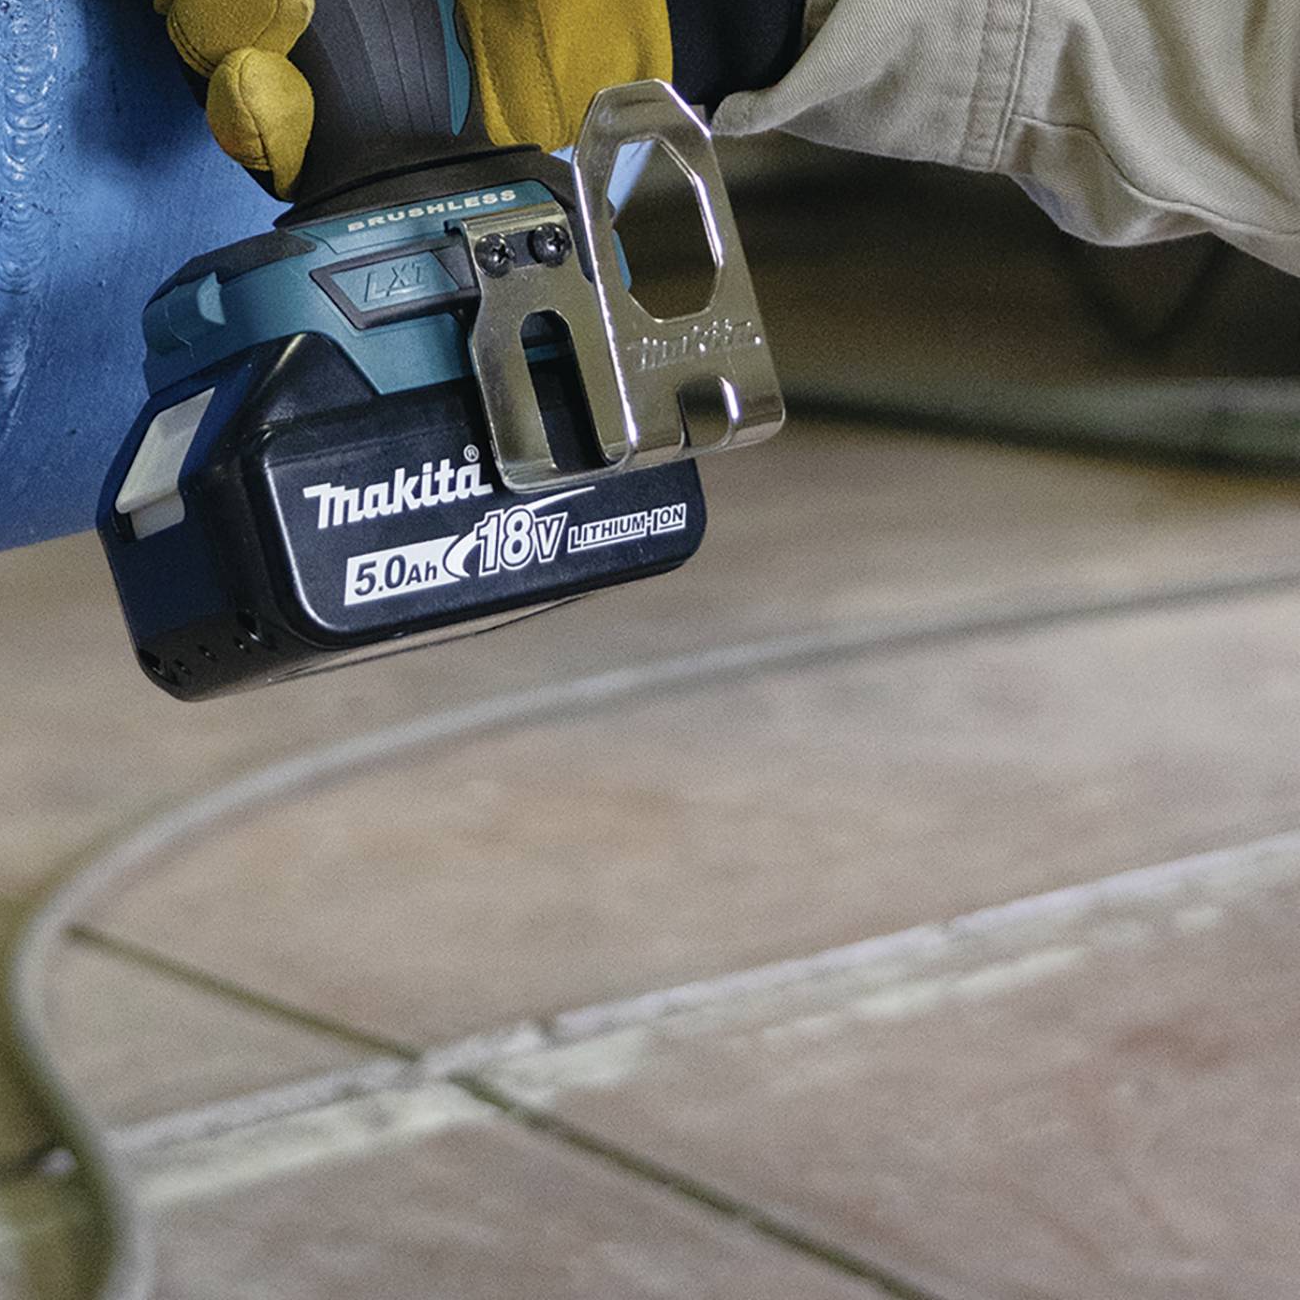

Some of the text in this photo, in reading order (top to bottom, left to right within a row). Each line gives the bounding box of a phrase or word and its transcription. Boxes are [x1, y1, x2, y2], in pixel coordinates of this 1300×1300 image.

[347, 189, 517, 233] BRUSHLESS
[354, 554, 438, 596] 5.0Ah
[567, 502, 686, 553] LITHIUM-ION
